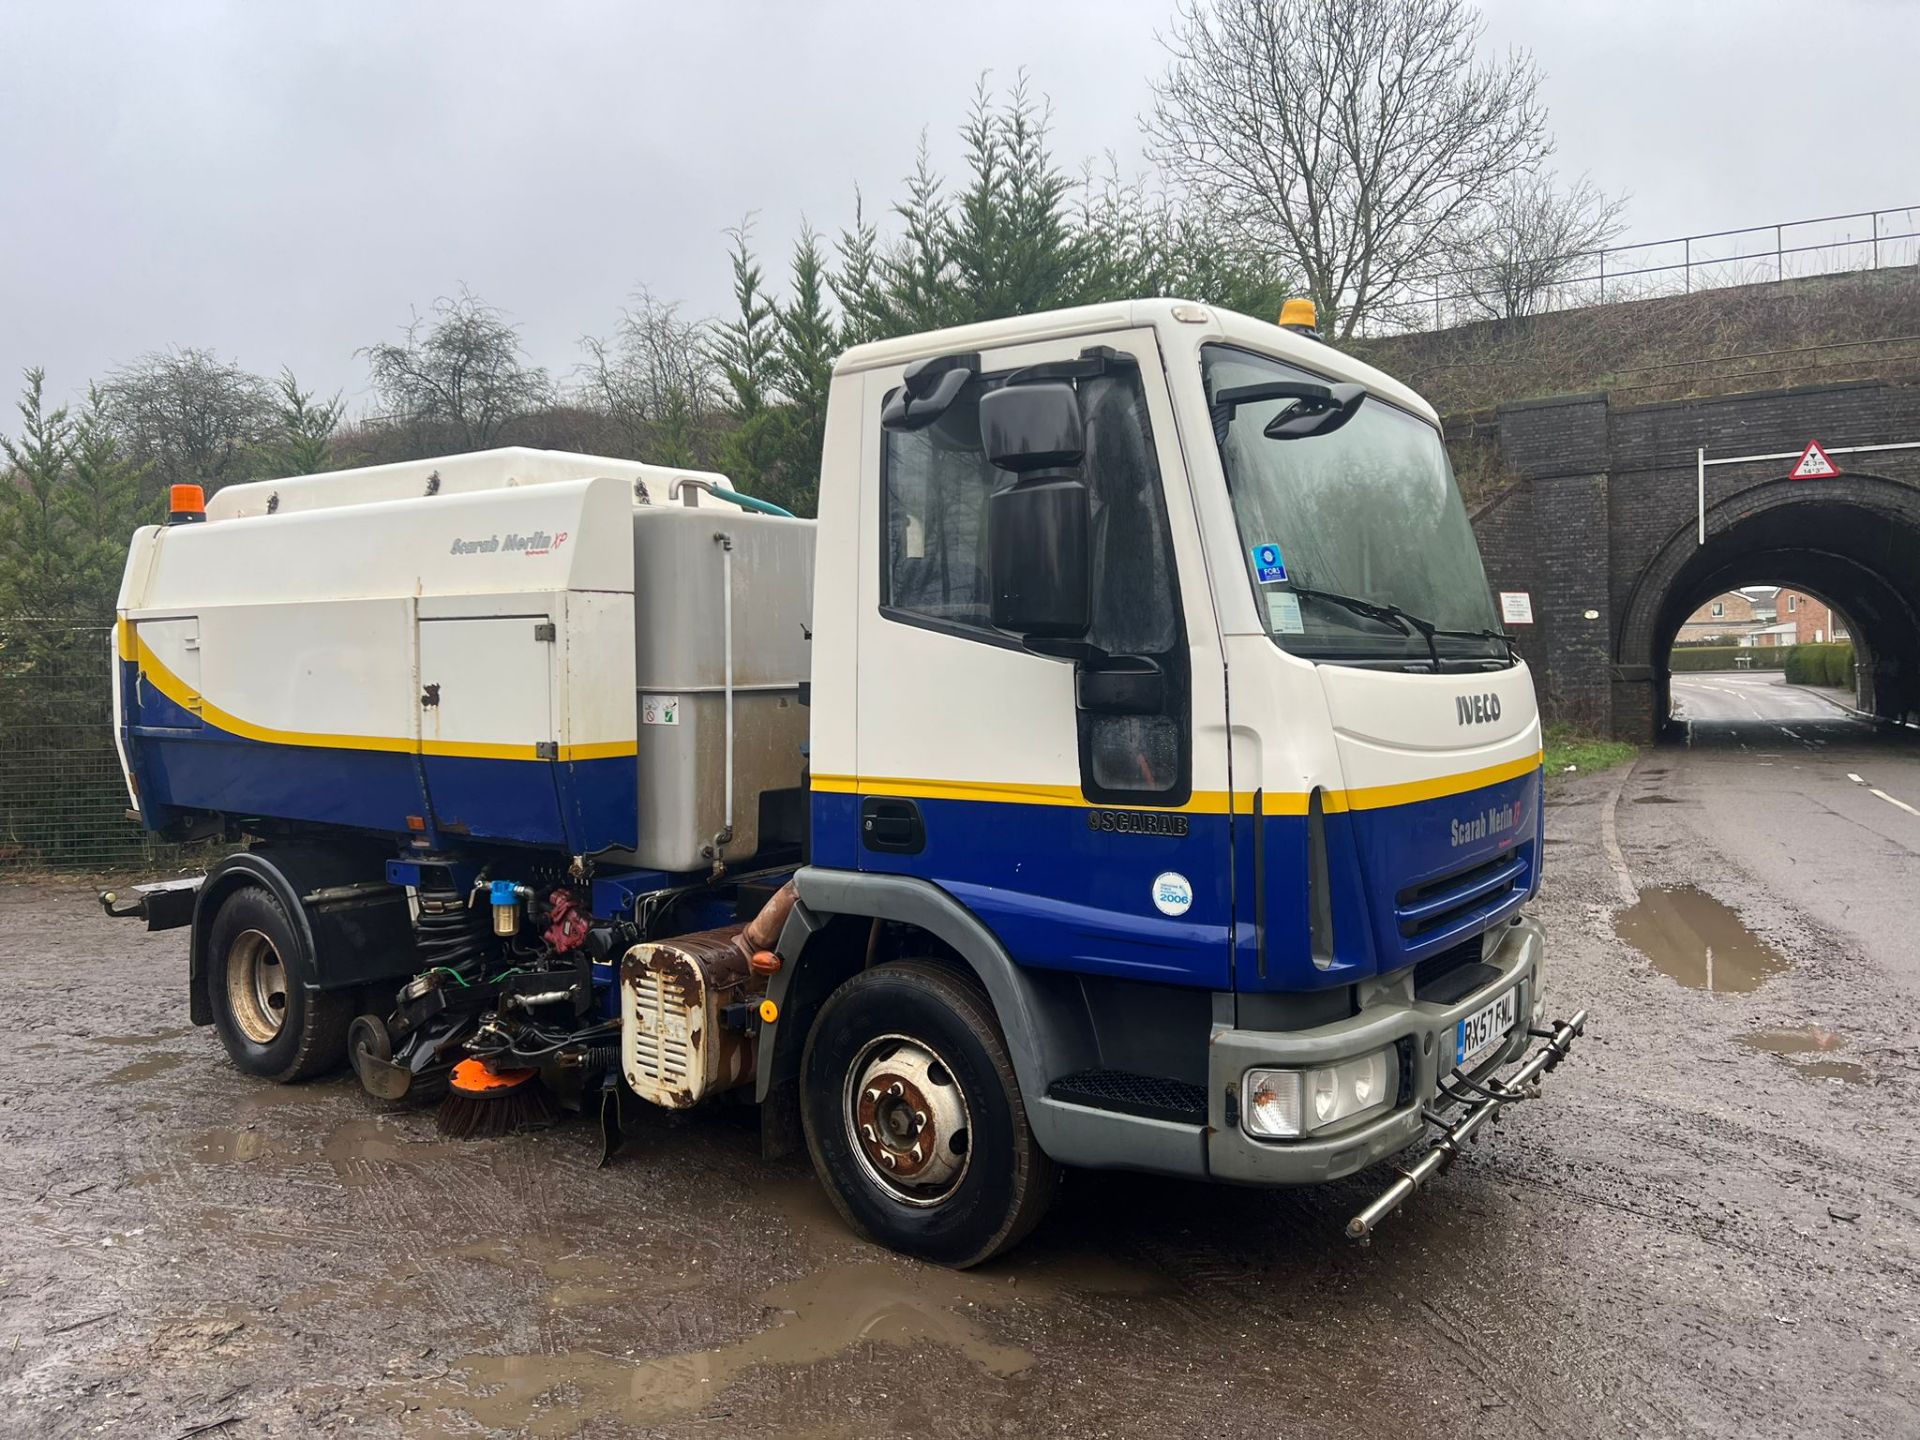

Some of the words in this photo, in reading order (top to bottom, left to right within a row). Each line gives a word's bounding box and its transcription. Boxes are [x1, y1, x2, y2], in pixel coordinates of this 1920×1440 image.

[450, 534, 500, 556] Scarab
[501, 530, 552, 552] Merlin
[1455, 693, 1501, 726] IVECO
[1101, 811, 1188, 836] SCARAB
[1451, 811, 1486, 848] Scarab
[1489, 803, 1513, 835] Merlin
[1160, 893, 1189, 905] 2006
[1464, 1008, 1493, 1053] RX57
